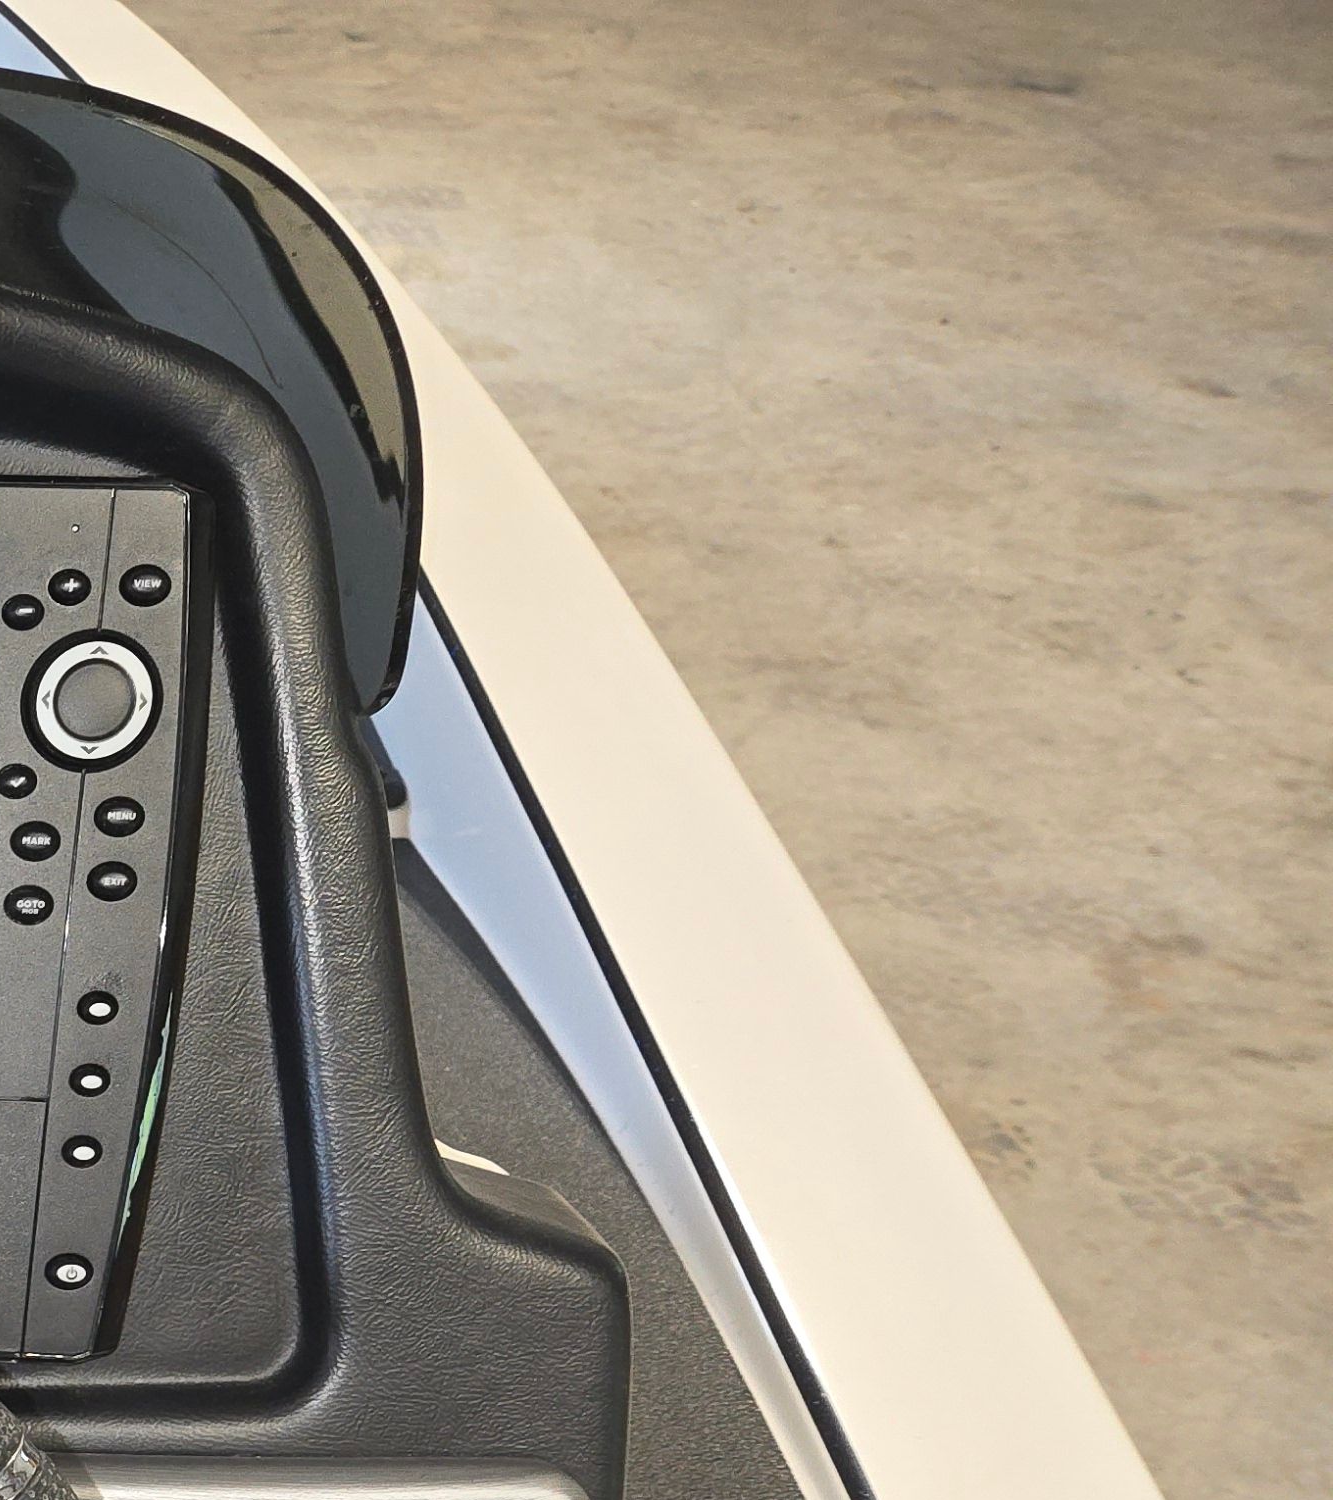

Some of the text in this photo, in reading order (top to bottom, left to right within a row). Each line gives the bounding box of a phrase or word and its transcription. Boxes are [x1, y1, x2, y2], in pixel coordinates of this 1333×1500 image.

[133, 578, 162, 589] VIEW
[106, 811, 137, 821] MENU
[21, 836, 52, 846] MARK
[103, 876, 128, 887] EXIT
